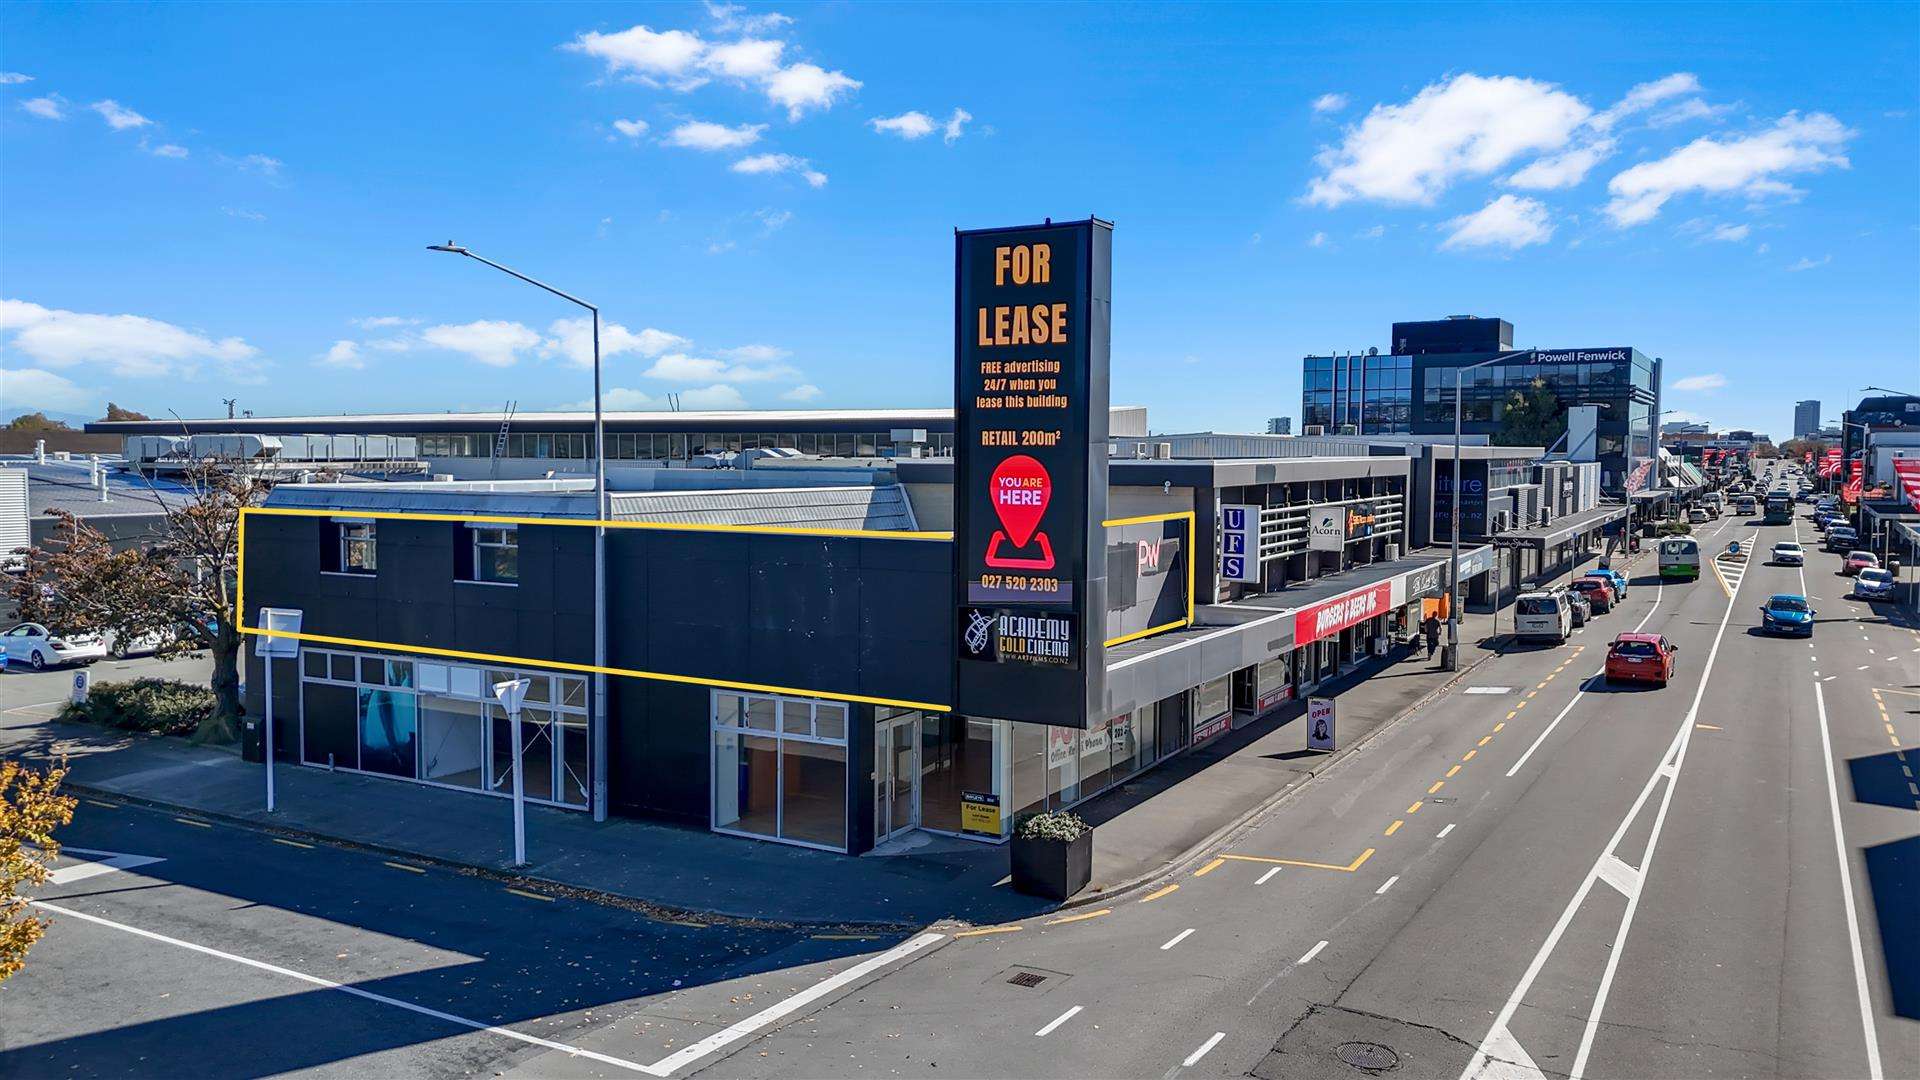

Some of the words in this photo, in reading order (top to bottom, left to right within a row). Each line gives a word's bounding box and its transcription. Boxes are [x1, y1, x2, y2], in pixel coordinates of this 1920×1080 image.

[995, 244, 1051, 286] FOR
[978, 304, 1068, 346] LEASE
[1537, 351, 1575, 362] Powell
[1576, 350, 1626, 361] Fenwick
[980, 360, 1002, 374] FREE
[1004, 359, 1060, 375] advertising
[984, 378, 1007, 391] 24/7
[1009, 378, 1035, 391] when
[1037, 379, 1057, 393] you
[976, 395, 1002, 409] lease
[1004, 394, 1024, 409] this
[1027, 394, 1068, 409] building
[981, 431, 1018, 446] RETAIL
[999, 490, 1042, 506] HERE
[1311, 525, 1342, 536] Acorn
[981, 575, 1003, 590] 027
[1005, 576, 1028, 591] 520
[1030, 577, 1058, 592] 2303
[998, 615, 1070, 641] ACADEMY
[999, 637, 1026, 653] GOLD
[1027, 639, 1069, 657] CINEMA
[1311, 707, 1331, 719] OPEN
[978, 805, 996, 813] Lease
